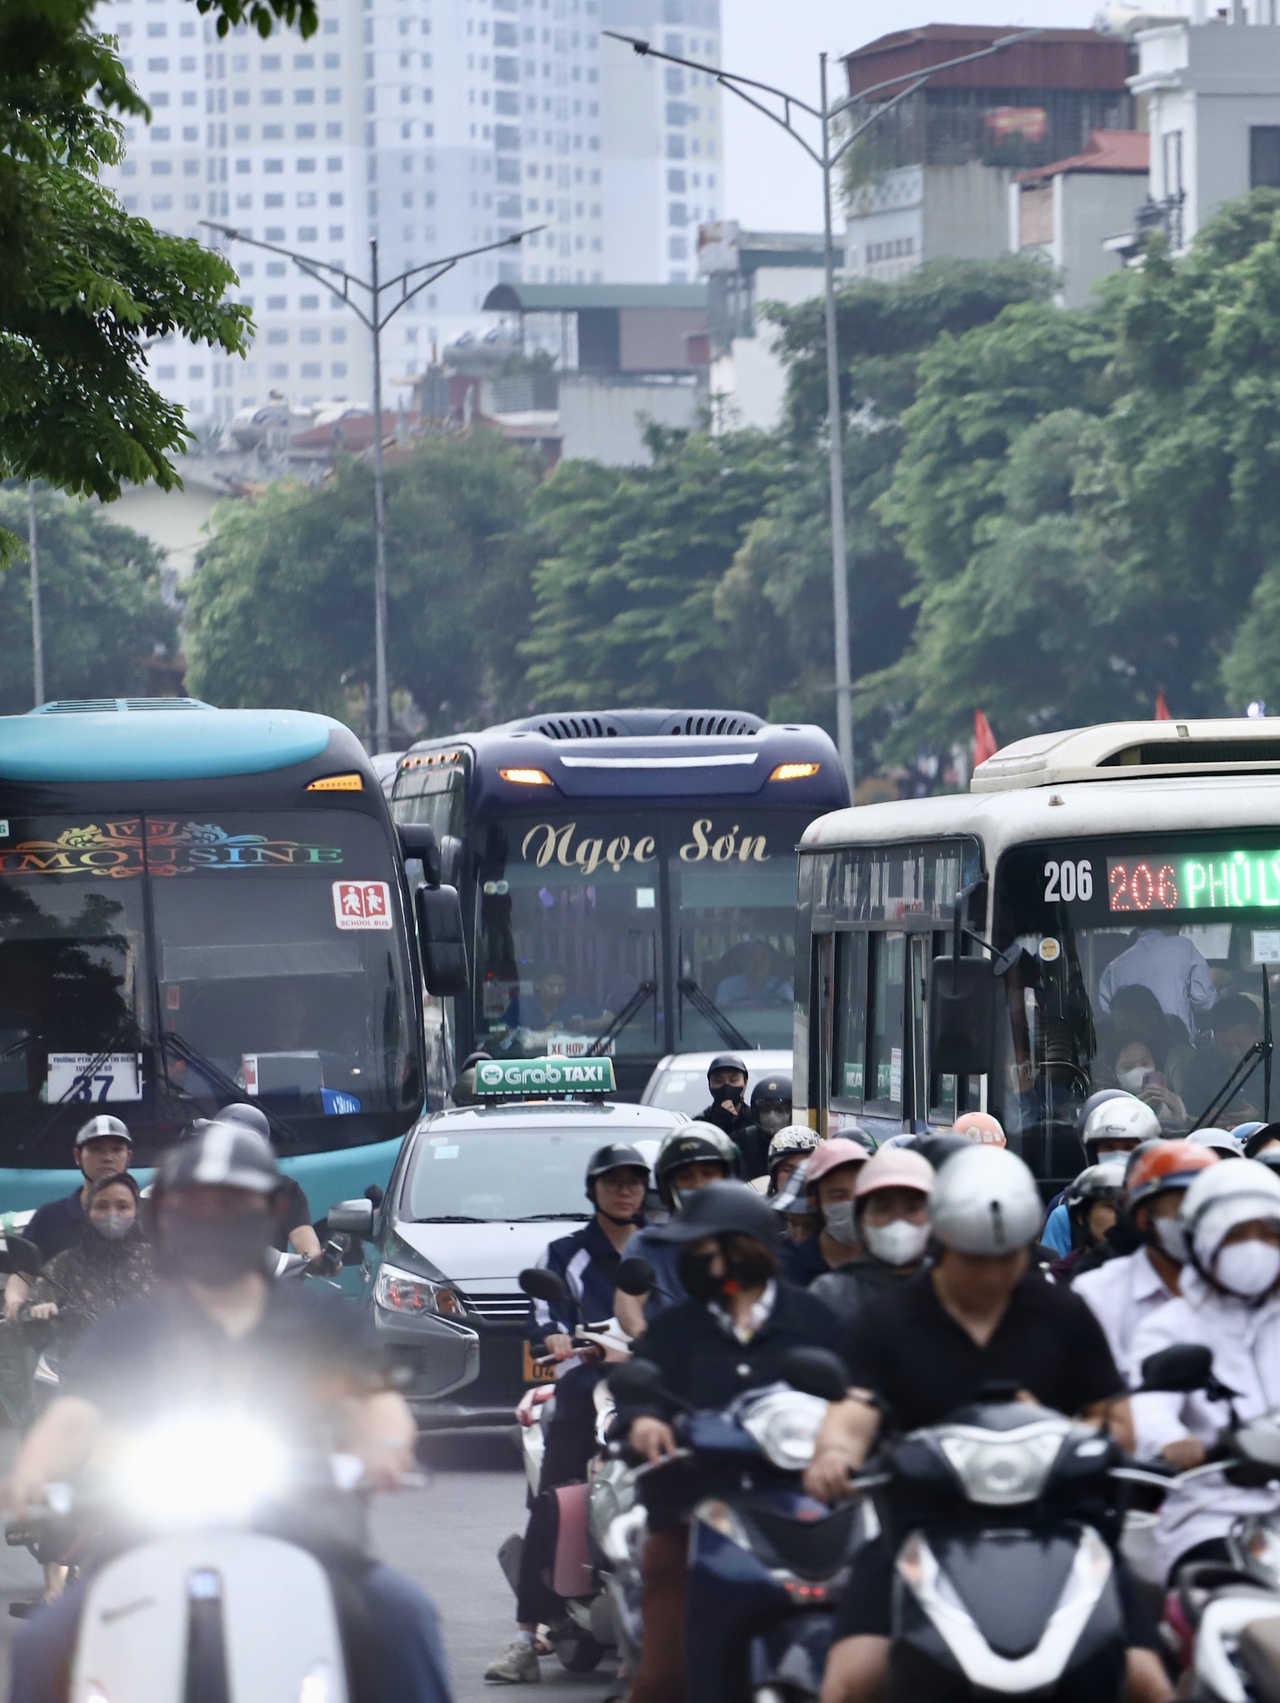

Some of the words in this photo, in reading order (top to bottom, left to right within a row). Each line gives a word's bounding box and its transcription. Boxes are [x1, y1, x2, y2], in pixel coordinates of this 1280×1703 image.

[521, 822, 657, 876] Ngọc
[679, 818, 771, 863] Sơn
[1043, 859, 1093, 902] 206
[1109, 864, 1179, 911] 206
[340, 919, 372, 927] SCHOOL
[373, 919, 389, 927] BUS
